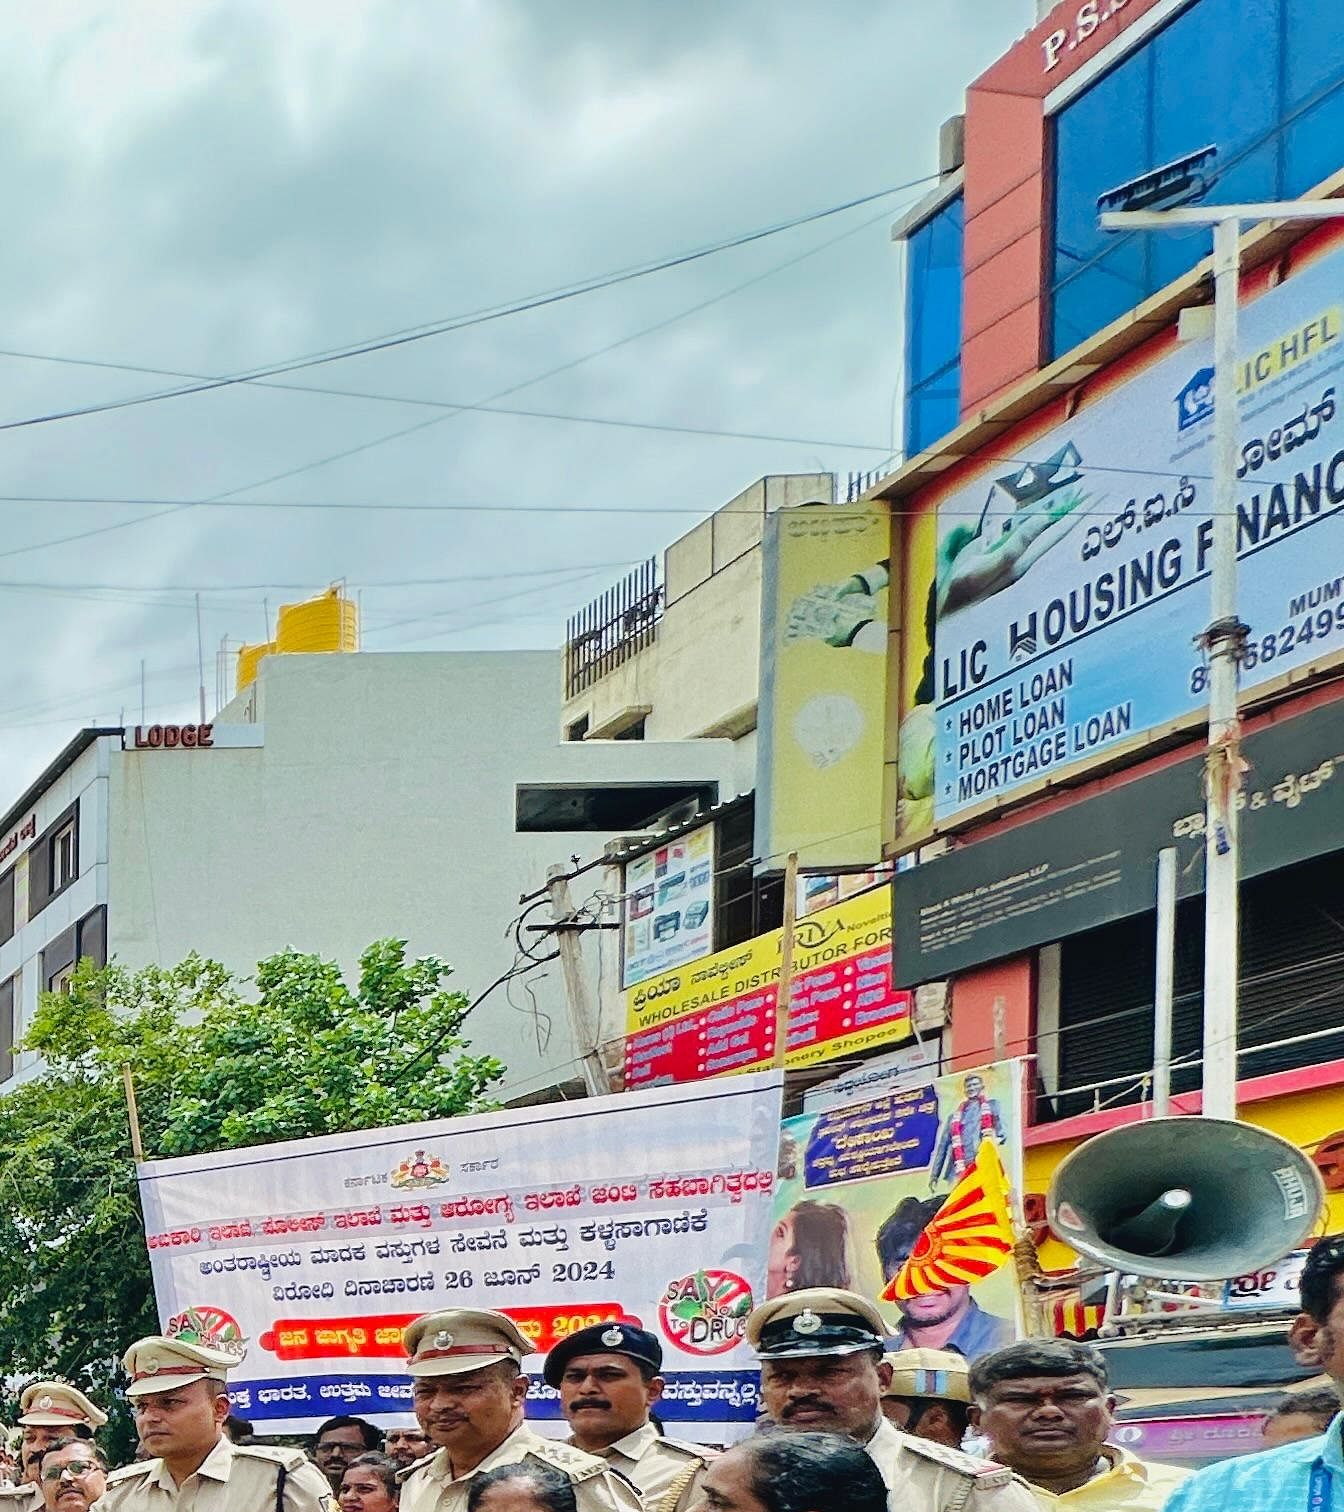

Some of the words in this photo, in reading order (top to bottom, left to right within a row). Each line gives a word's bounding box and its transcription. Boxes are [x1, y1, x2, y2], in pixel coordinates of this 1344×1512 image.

[1235, 351, 1271, 393] IC
[1280, 315, 1338, 370] HFL
[943, 639, 988, 700] LIC
[1008, 537, 1181, 662] HOUSING
[1196, 446, 1344, 573] FNANC
[134, 723, 214, 748] LODGE
[959, 690, 1014, 738] HOME
[1019, 657, 1074, 701] LOAN
[959, 731, 1005, 772] PLOT
[1011, 696, 1065, 748] LOAN
[957, 741, 1067, 804] MORTGAGE
[1073, 701, 1132, 755] LOAN
[638, 985, 730, 1028] WHOLESALE
[734, 935, 848, 994] DISTRBUTOR
[309, 1240, 368, 1265] ಮಾದಕ
[374, 1234, 442, 1264] ವಸ್ತುಗಳ
[449, 1226, 510, 1253] ಸೇವನೆ
[518, 1222, 570, 1252] ಮತ್ತು
[444, 1270, 473, 1291] 26
[483, 1262, 541, 1288] ಜೂನ್
[552, 1259, 617, 1284] 2024
[690, 1314, 747, 1345] DRUG
